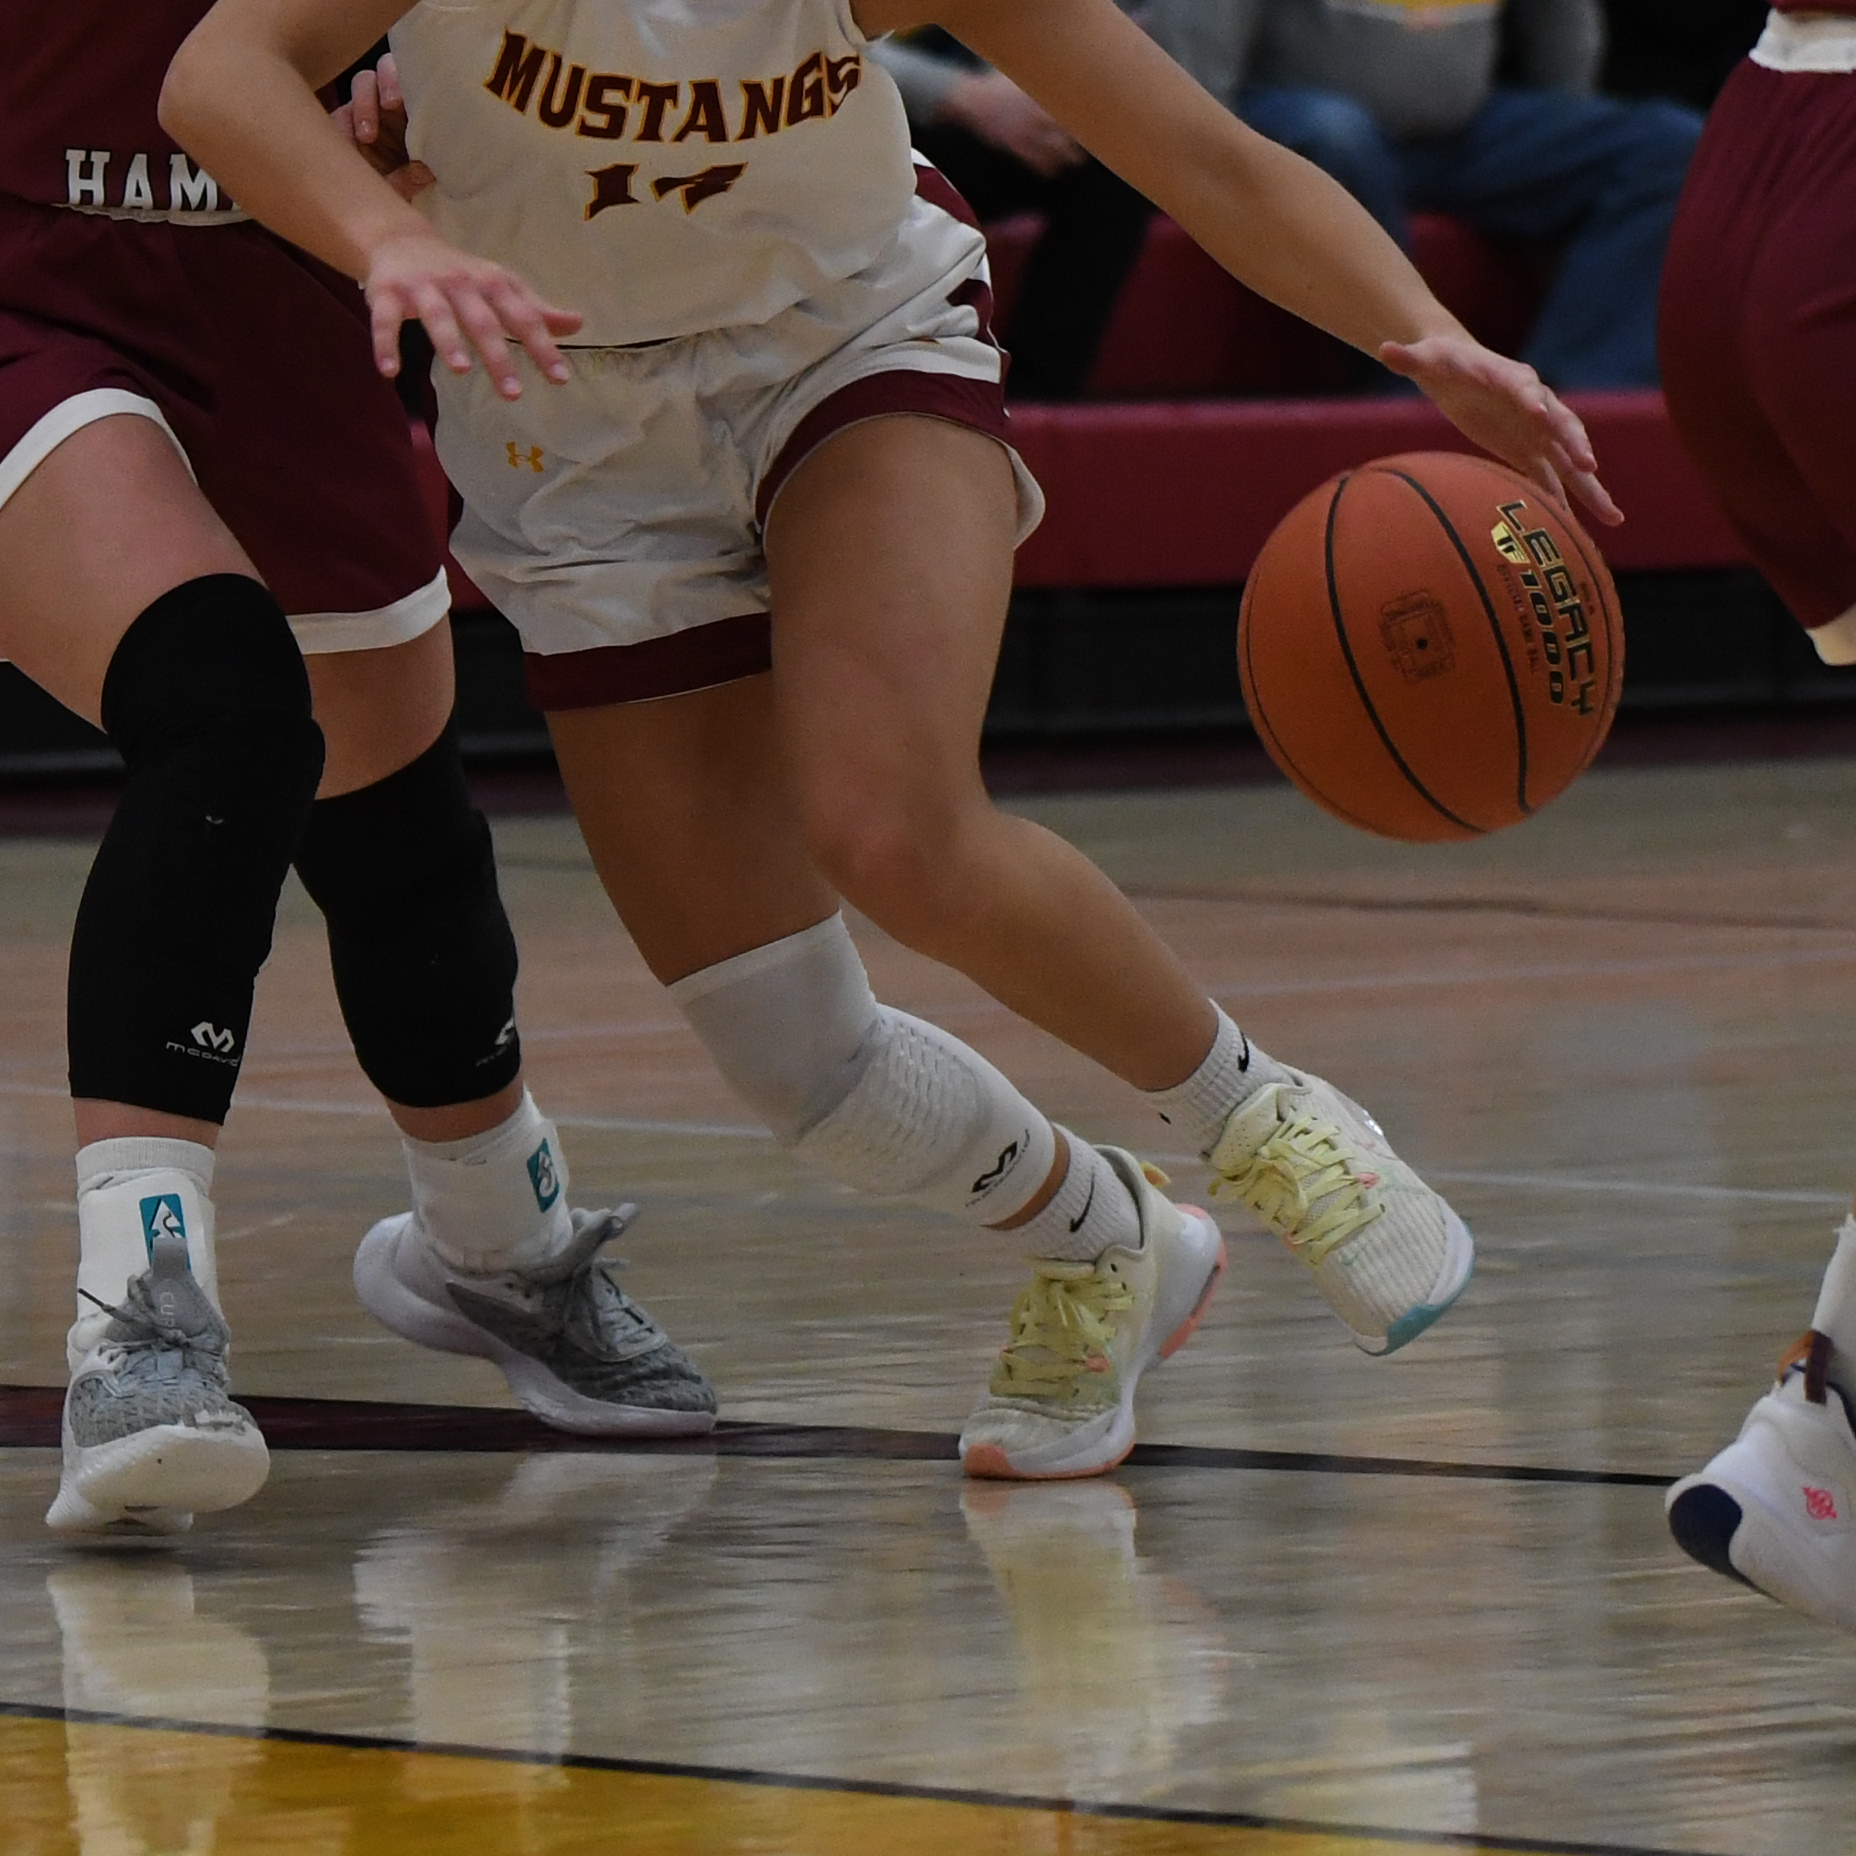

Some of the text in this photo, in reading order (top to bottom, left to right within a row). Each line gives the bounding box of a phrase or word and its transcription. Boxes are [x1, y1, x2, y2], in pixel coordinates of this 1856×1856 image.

[483, 24, 861, 144] MUSTANGS
[1496, 499, 1595, 716] LEGACY
[1520, 569, 1565, 705] 1000
